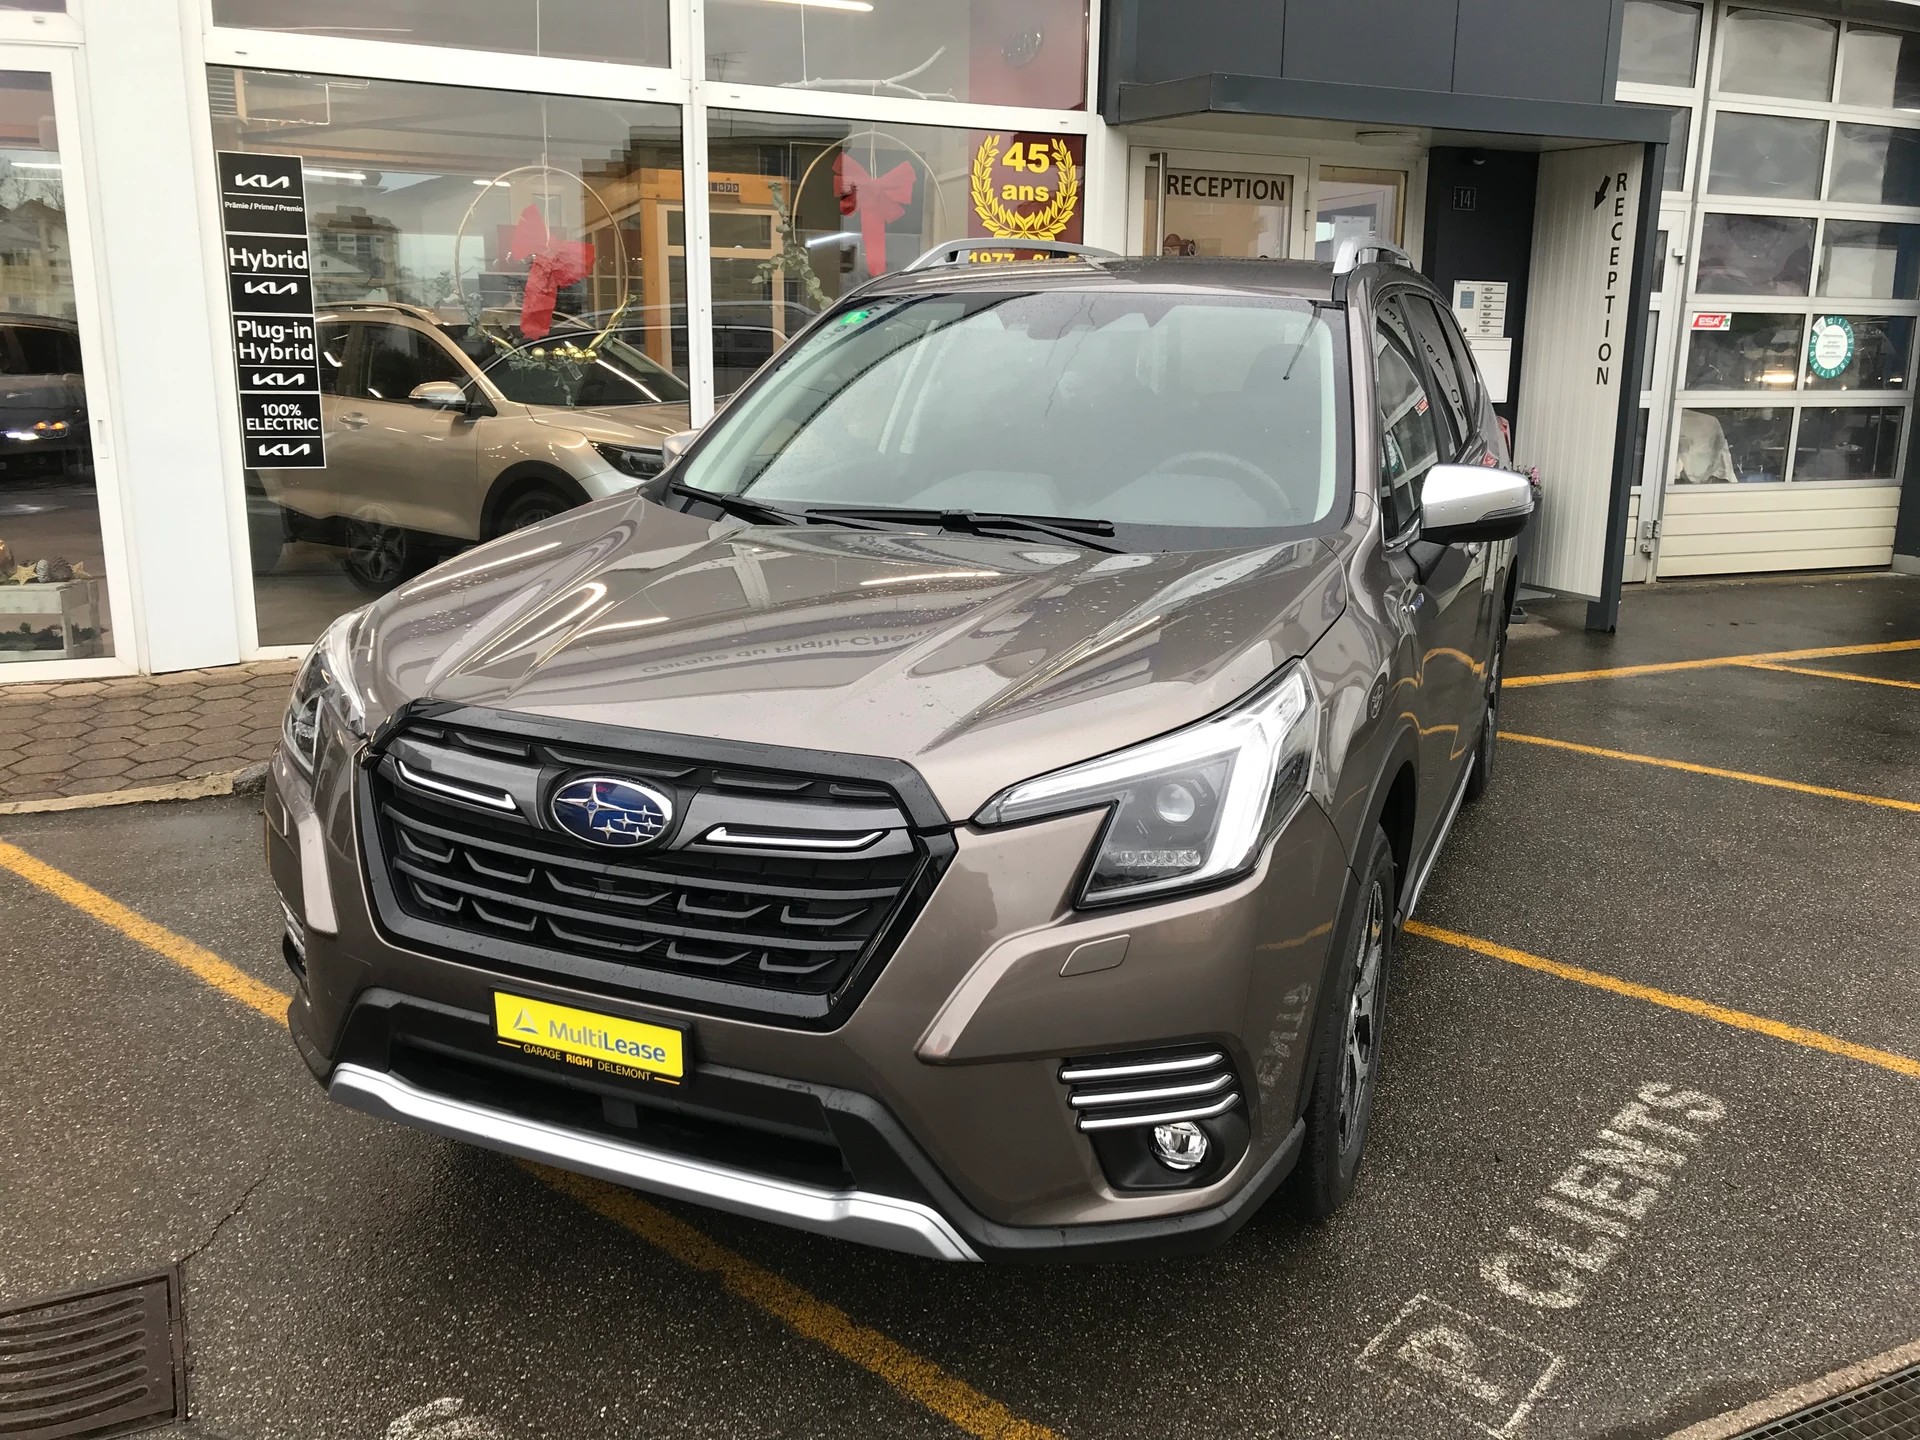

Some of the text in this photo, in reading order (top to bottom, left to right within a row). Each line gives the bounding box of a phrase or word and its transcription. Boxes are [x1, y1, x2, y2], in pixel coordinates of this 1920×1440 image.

[1002, 142, 1049, 173] 45
[234, 173, 290, 189] KIA
[1166, 174, 1285, 201] RECEPTION
[1001, 184, 1049, 202] ans
[1460, 190, 1471, 208] 14
[224, 201, 249, 210] Prämie
[254, 203, 274, 211] Prime
[279, 204, 303, 212] Premio
[228, 247, 308, 272] Hybrid
[244, 281, 298, 295] KIA
[1595, 172, 1628, 385] RECEPTION
[236, 320, 313, 343] Plug-in
[238, 342, 314, 364] Hybrid
[252, 373, 305, 386] KIA
[260, 403, 302, 417] 100%
[246, 417, 319, 431] ELECTRIC
[258, 443, 311, 456] KIA
[549, 1020, 666, 1063] MultiLease
[523, 1043, 651, 1081] GARAGE RIGHI DELEMONT
[1479, 1081, 1728, 1309] CLIENTS
